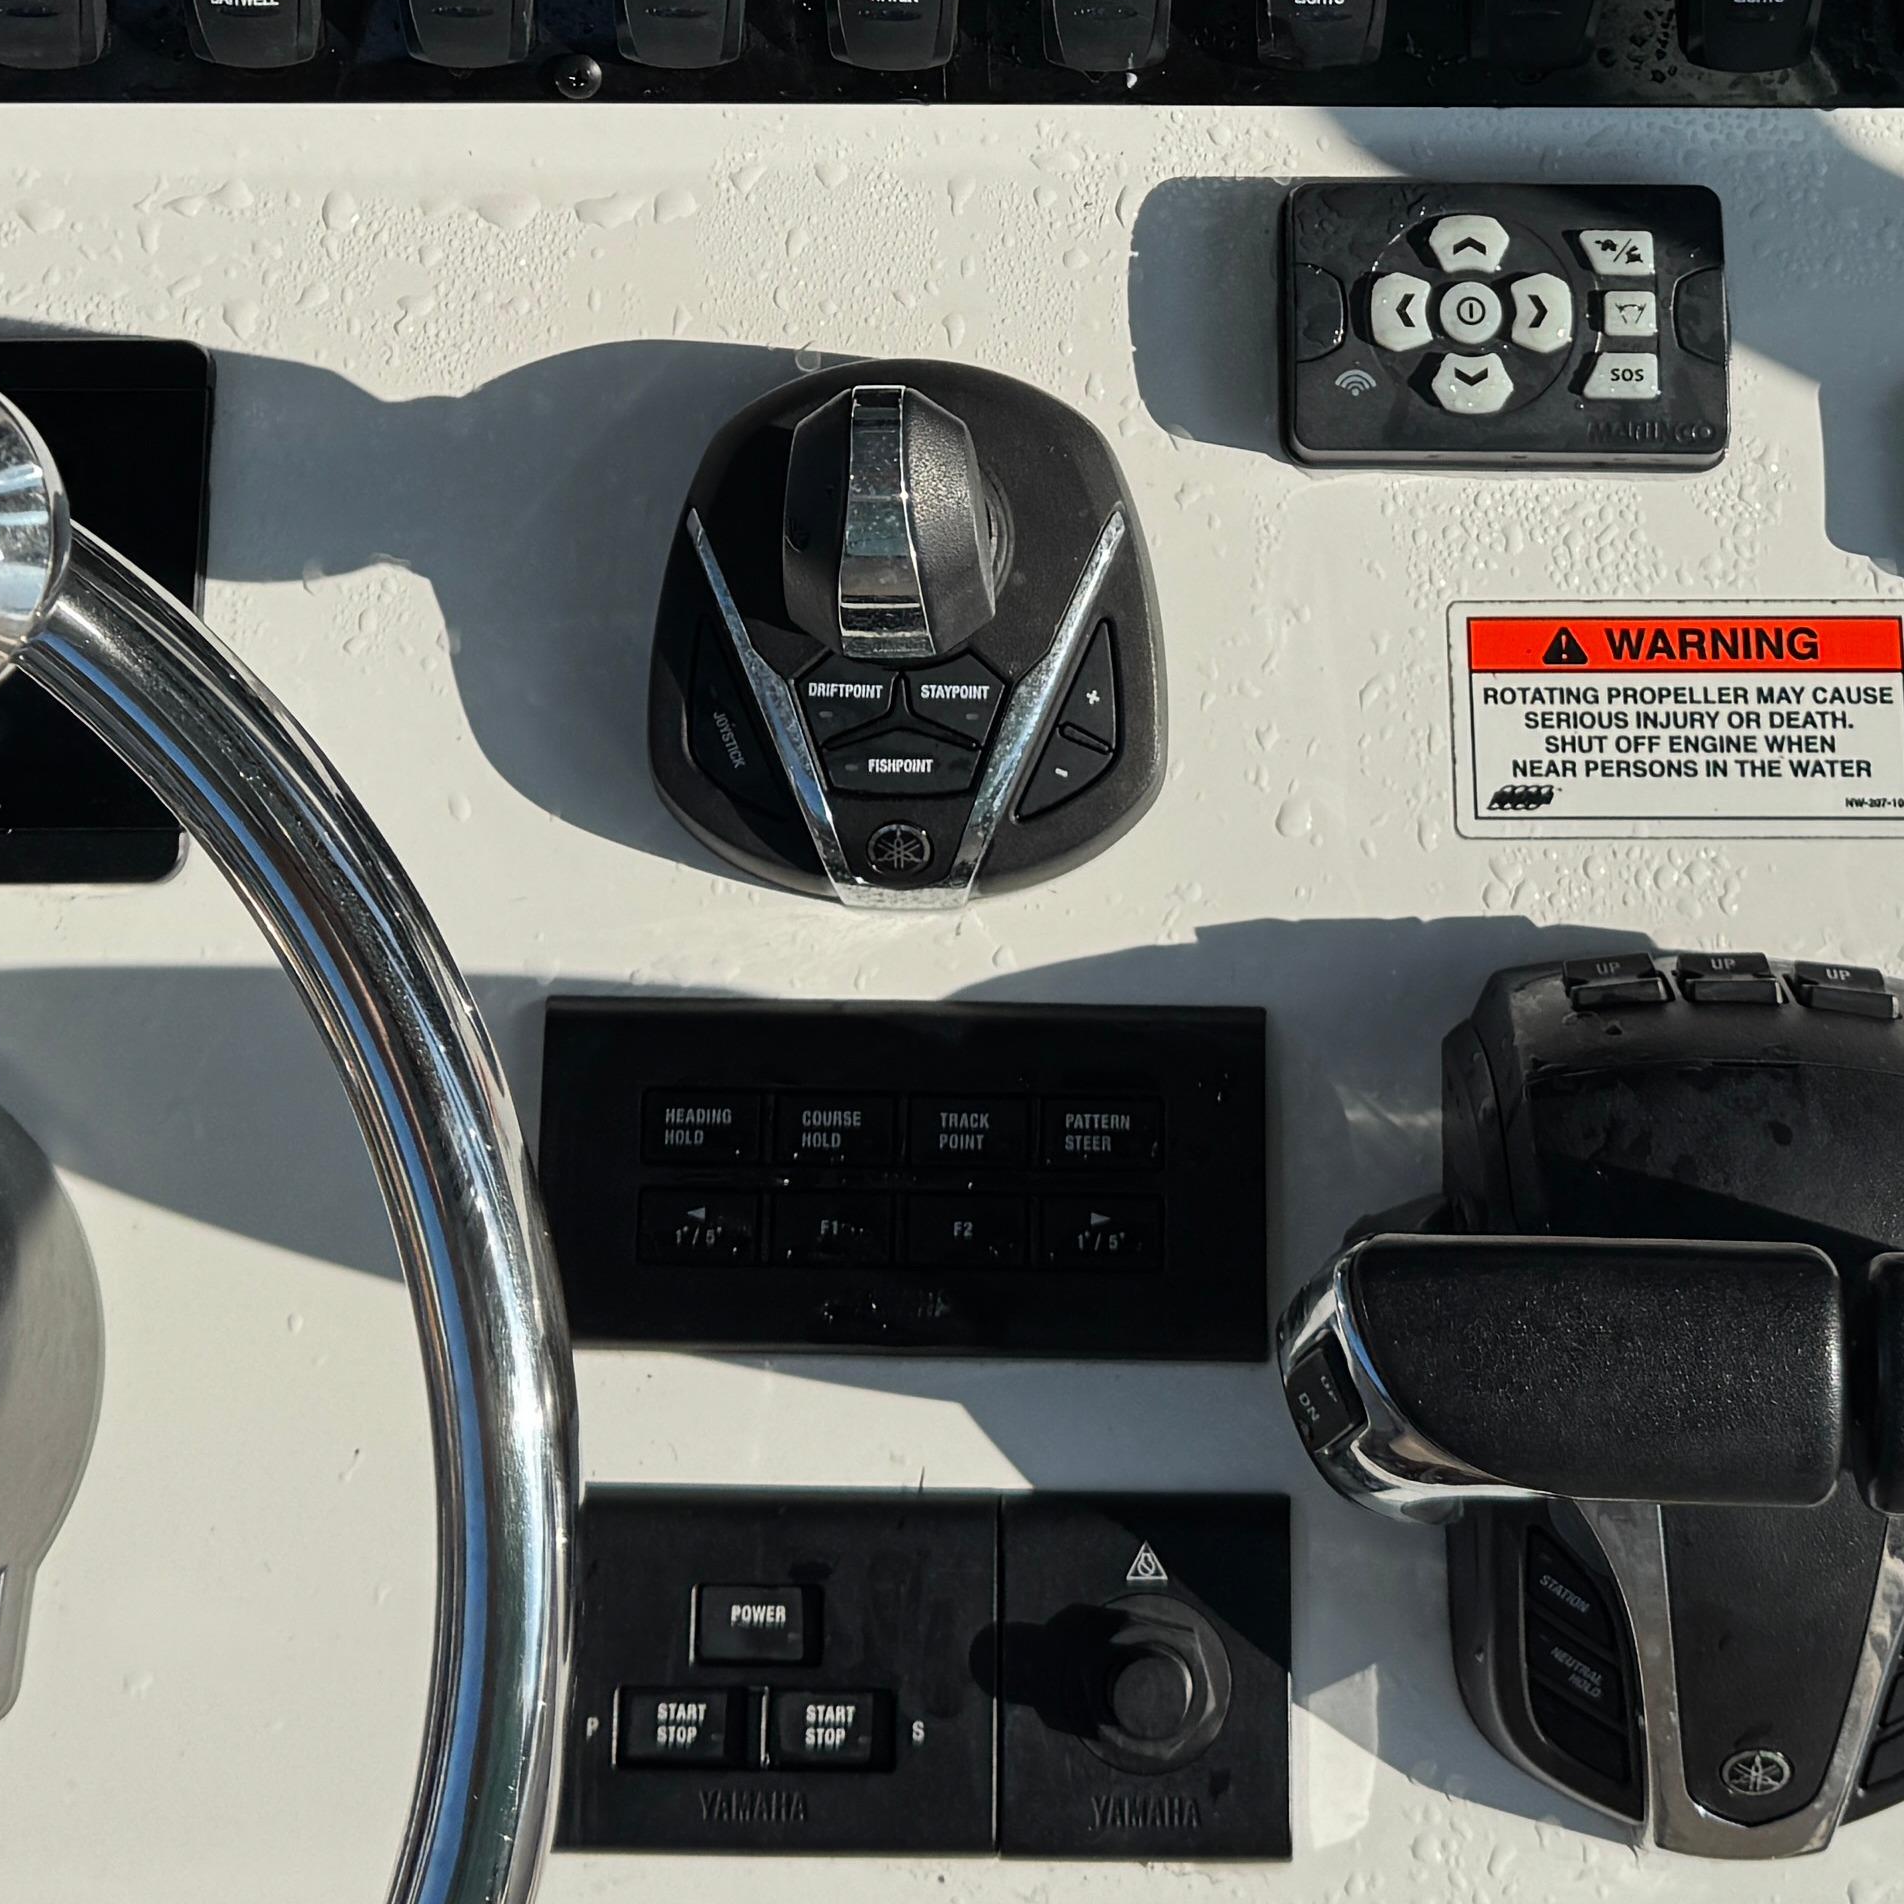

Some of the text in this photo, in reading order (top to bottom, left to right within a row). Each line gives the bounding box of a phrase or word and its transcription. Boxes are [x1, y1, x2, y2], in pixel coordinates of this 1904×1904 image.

[1610, 368, 1644, 382] SOS
[1605, 626, 1819, 663] WARNING
[808, 682, 884, 699] DRIFTPOINT
[920, 684, 990, 700] STAYPOINT
[1483, 686, 1893, 705] ROTATING PROPELLER MAY CAUSE
[1524, 710, 1854, 729] SERIOUS INJURY OR DEATH.
[712, 710, 747, 770] JOYSTICK
[1545, 735, 1836, 753] SHUT OFF ENGINE WHEN
[868, 759, 934, 774] FISHPOINT
[1512, 759, 1872, 778] NEAR PERSONS IN THE WATER
[1596, 962, 1620, 975] UP
[1710, 958, 1736, 971] UP
[1826, 968, 1852, 981] UP
[665, 1108, 732, 1125] HEADING
[802, 1110, 862, 1127] COURSE
[939, 1112, 990, 1129] TRACK
[1065, 1113, 1130, 1131] PATTERN
[664, 1129, 704, 1145] HOLD
[801, 1132, 841, 1148] HOLD
[938, 1133, 985, 1150] POINT
[1064, 1134, 1112, 1152] STEER
[820, 1219, 838, 1236] F1
[953, 1221, 973, 1238] F2
[1540, 1575, 1590, 1613] STATION
[731, 1605, 786, 1622] POWER
[1551, 1647, 1602, 1686] NEUTRAL
[1568, 1673, 1601, 1698] HOLD
[657, 1703, 707, 1720] START
[806, 1705, 856, 1722] START
[656, 1726, 696, 1743] STOP
[805, 1728, 845, 1745] STOP
[912, 1720, 924, 1740] S
[699, 1789, 807, 1822] YAMAHA
[1090, 1794, 1202, 1827] YAMAHA
